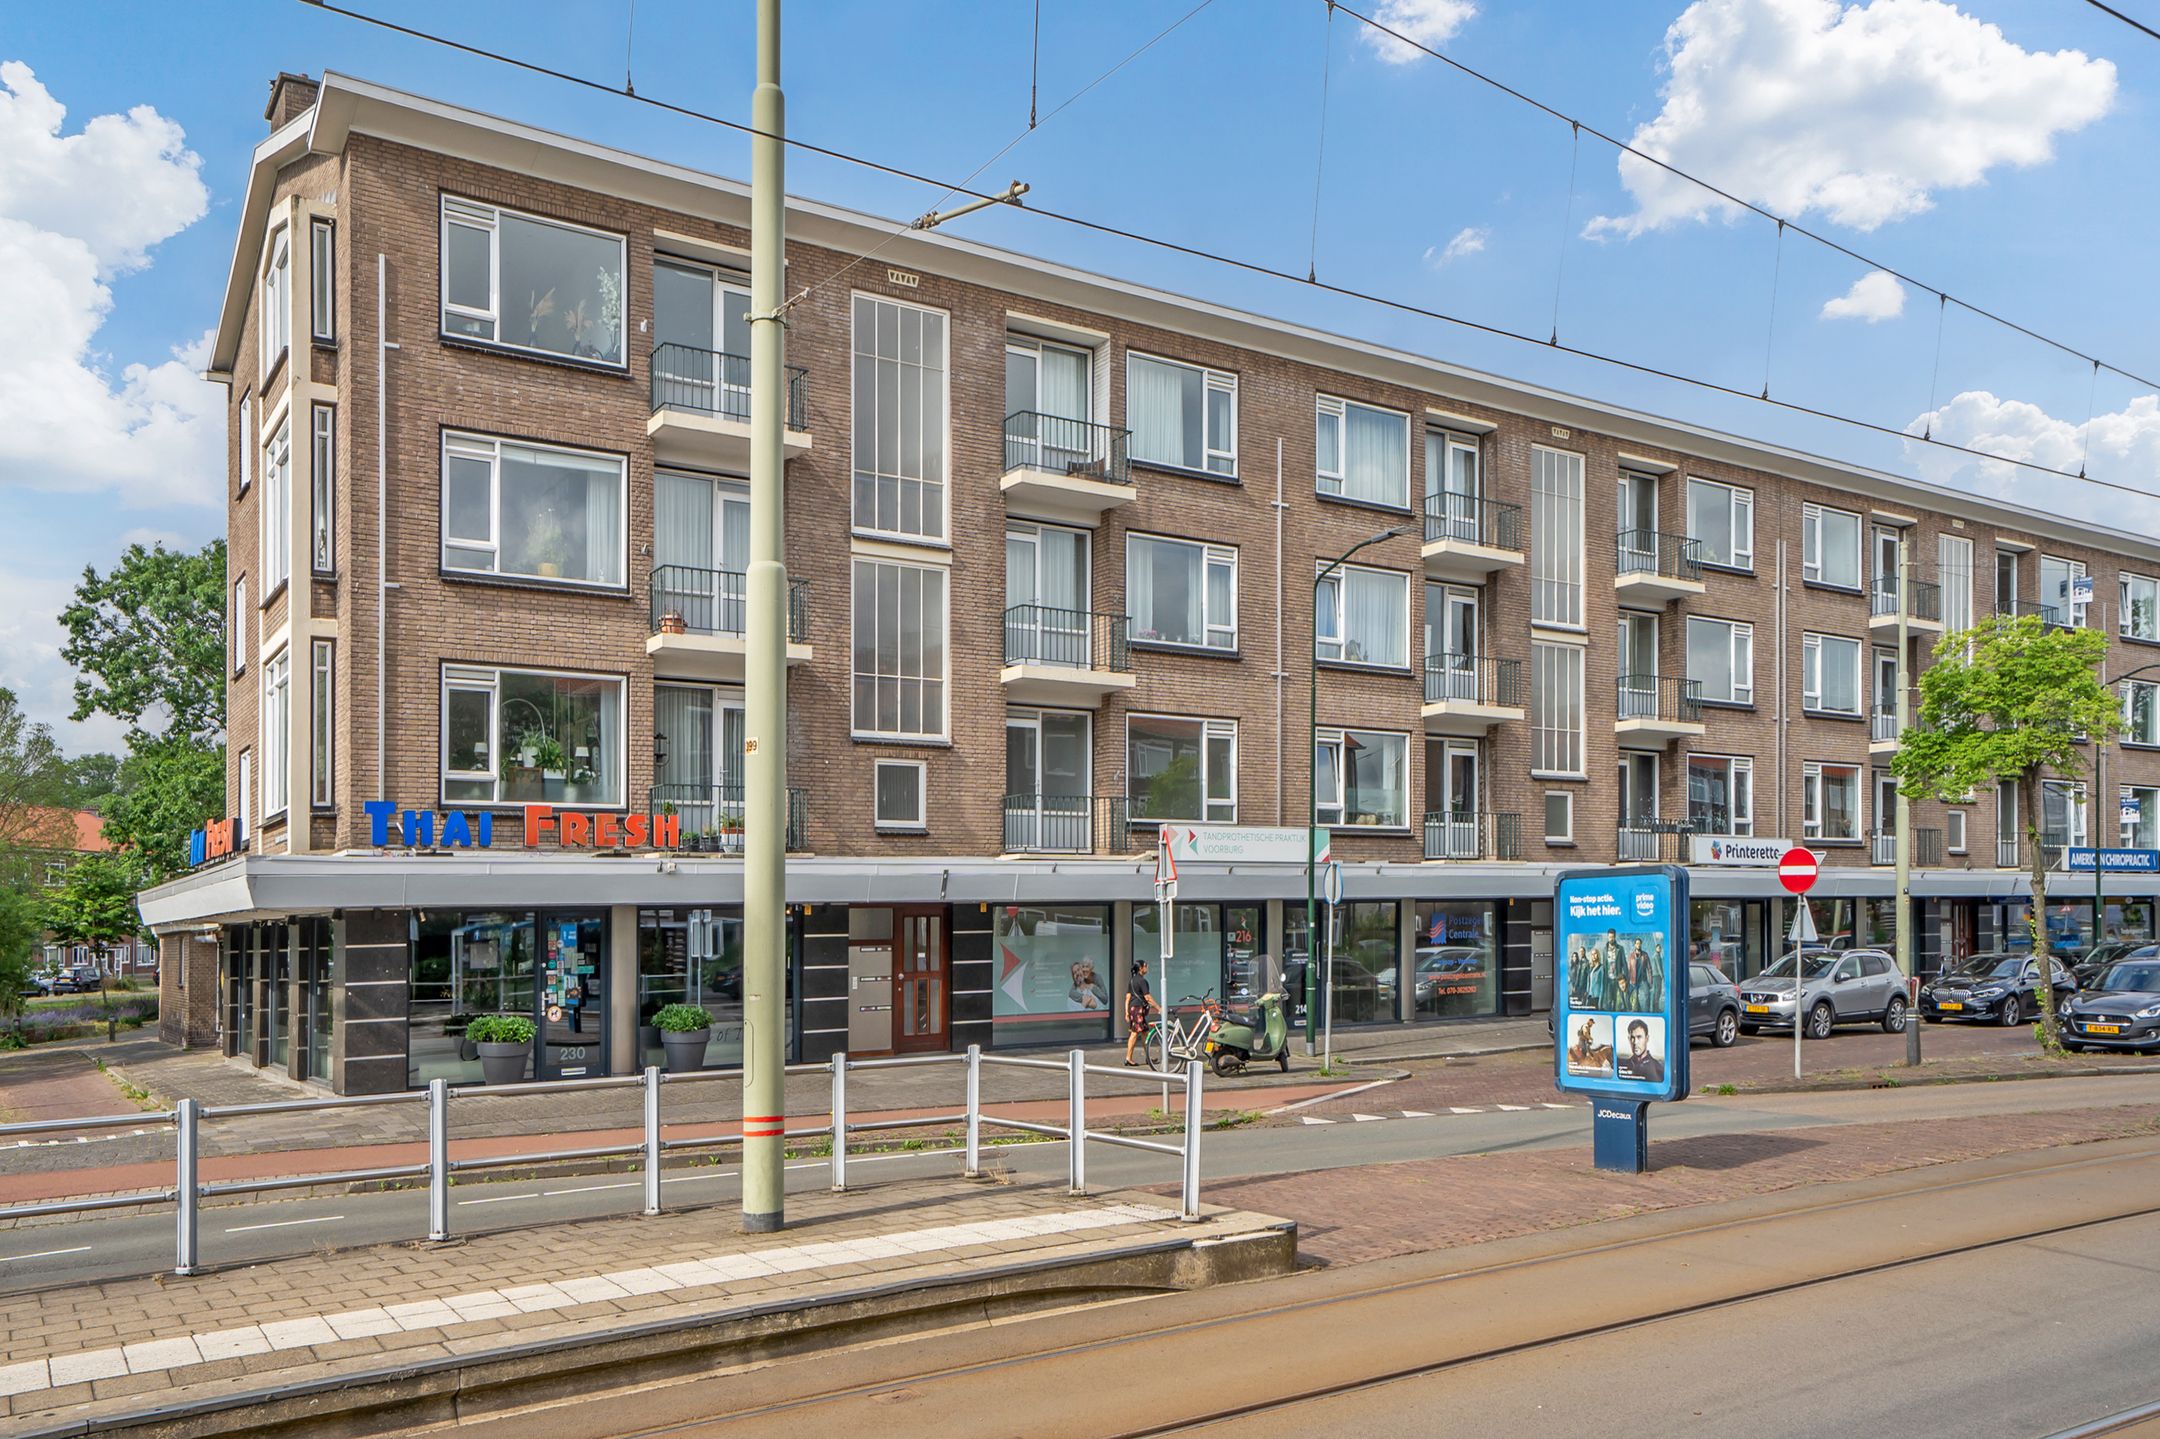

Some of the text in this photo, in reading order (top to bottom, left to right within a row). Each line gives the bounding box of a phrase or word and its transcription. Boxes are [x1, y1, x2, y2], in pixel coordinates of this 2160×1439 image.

[363, 801, 679, 847] THAI FRESH
[1203, 832, 1306, 843] TANDPROTHETISCHE PRAKTIJK
[1204, 844, 1244, 854] VOORBURG
[1726, 843, 1779, 860] Printerette
[2071, 852, 2150, 867] AMERICN CHIROPRACTIC
[1570, 894, 1615, 904] Non-stop actie.
[1636, 893, 1654, 903] prime
[1570, 904, 1622, 918] Kijk het hier.
[1636, 902, 1654, 910] video
[1236, 931, 1252, 943] 216
[1449, 928, 1479, 939] Centrale
[560, 1046, 586, 1060] 230
[1598, 1109, 1632, 1120] JCDecaux
